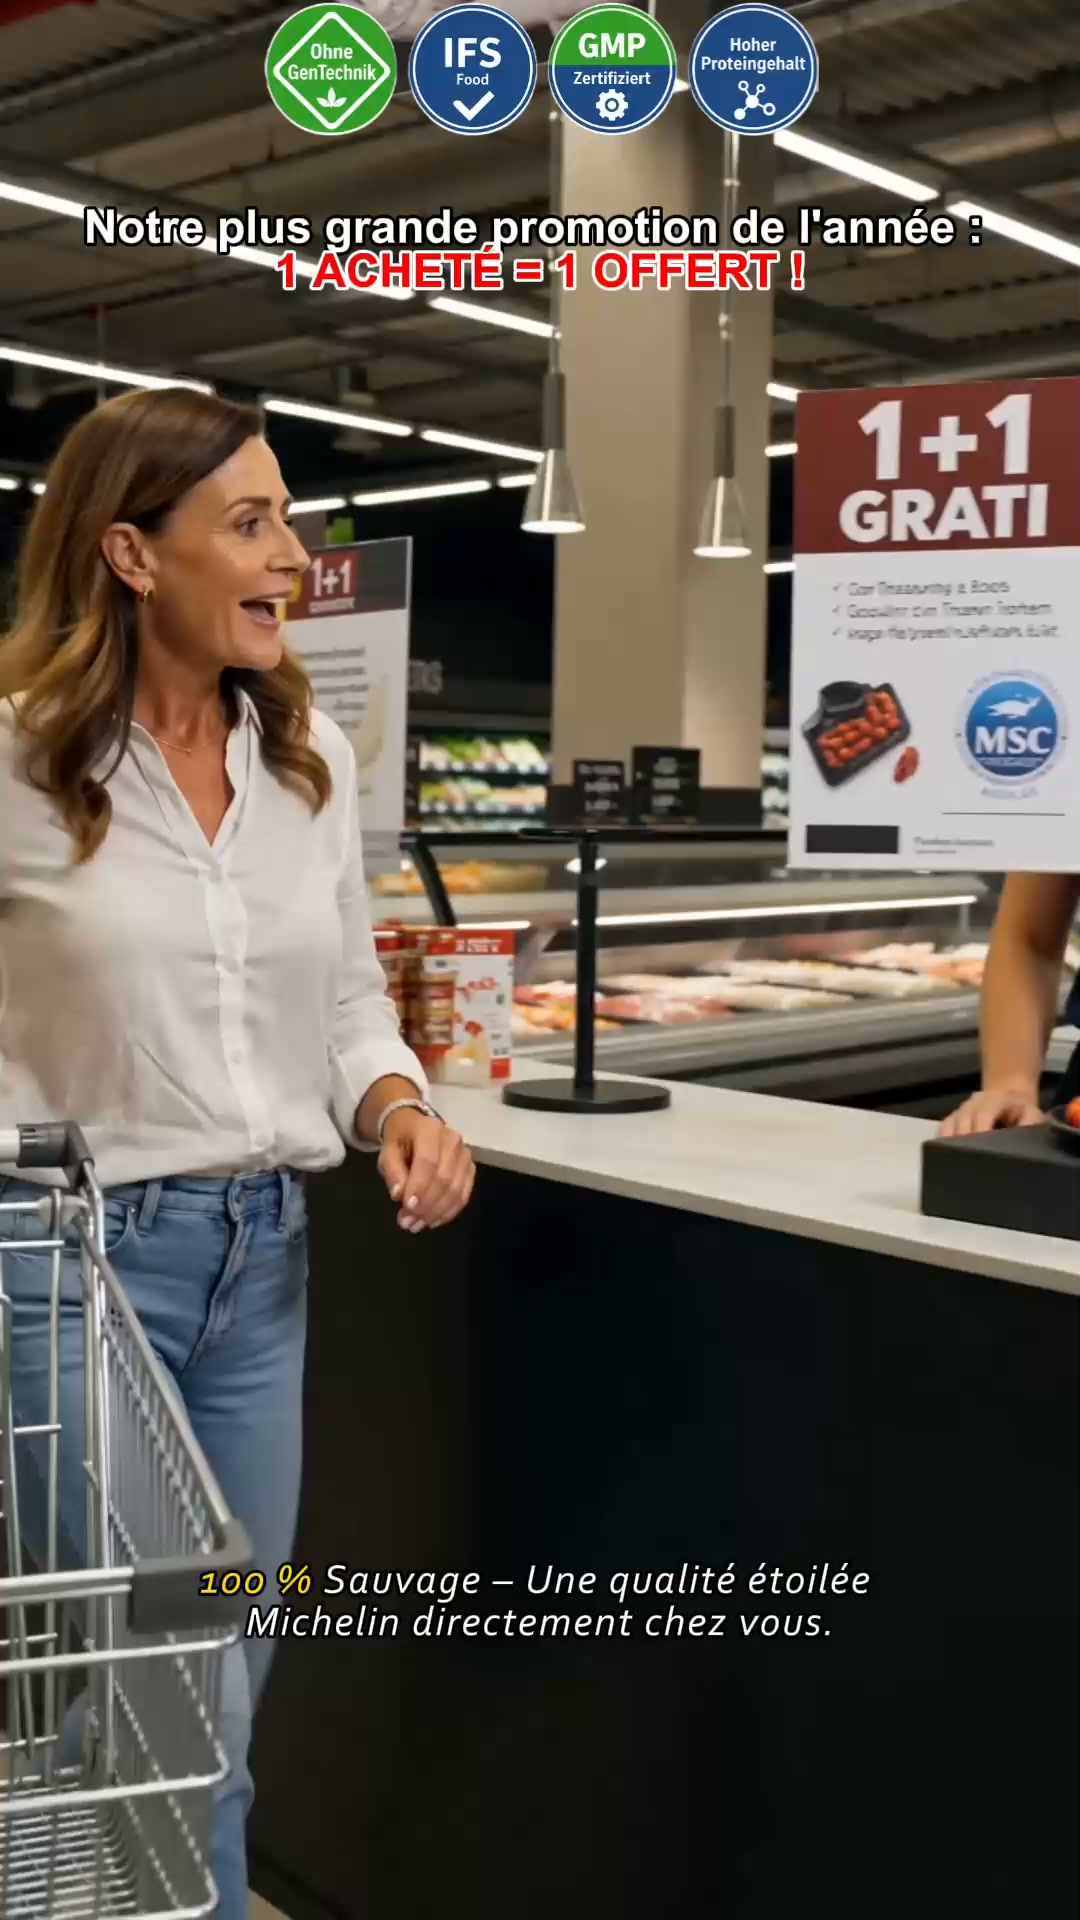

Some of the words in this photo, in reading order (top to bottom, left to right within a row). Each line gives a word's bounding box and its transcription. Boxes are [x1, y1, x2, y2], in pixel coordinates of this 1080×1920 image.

[857, 393, 1032, 481] 1+1
[838, 483, 1049, 544] GRATI
[310, 557, 352, 597] 1+1
[975, 725, 1053, 755] MSC
